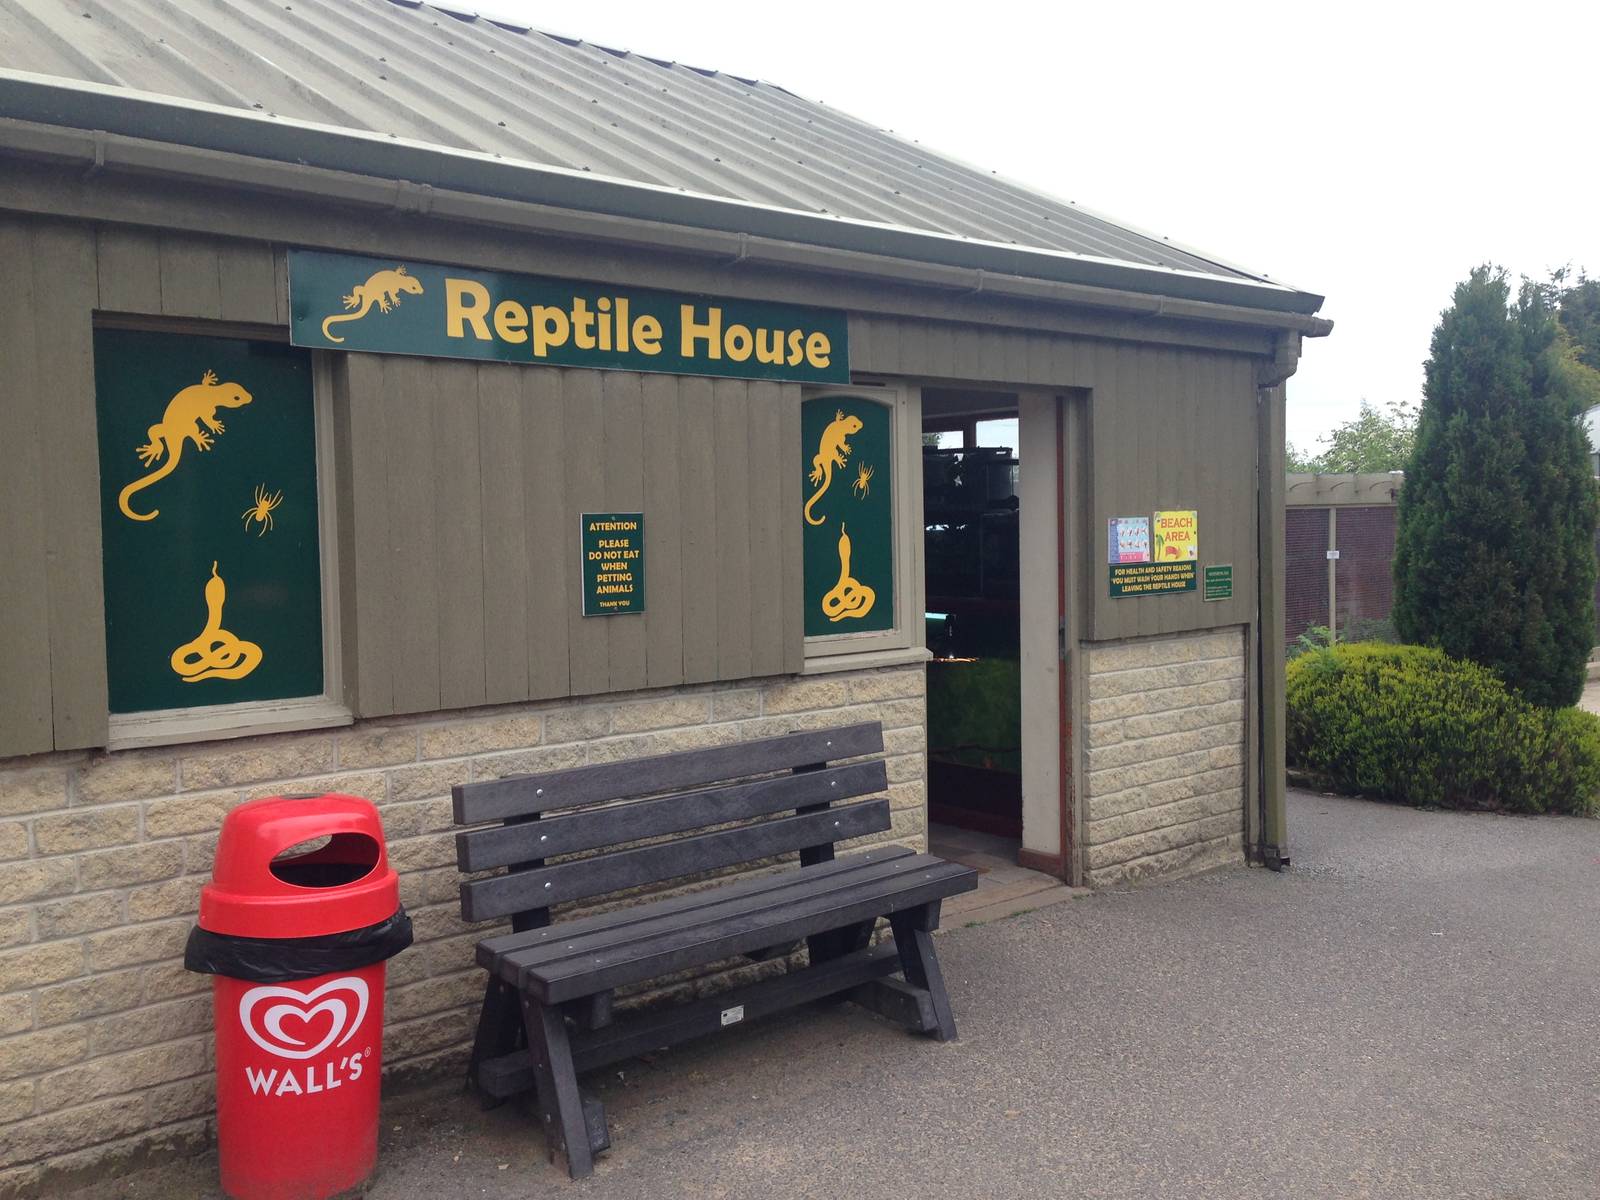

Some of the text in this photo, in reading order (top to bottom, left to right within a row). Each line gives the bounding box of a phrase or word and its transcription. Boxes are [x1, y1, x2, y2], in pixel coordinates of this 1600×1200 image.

[444, 277, 831, 369] Reptile House
[590, 522, 637, 531] ATTENTION
[1161, 517, 1192, 528] BEACH
[1165, 531, 1190, 542] AREA
[599, 539, 629, 548] PLEASE
[589, 550, 640, 560] DO NOT EAT
[601, 562, 628, 571] WHEN
[1156, 565, 1173, 573] SAFETY
[597, 573, 633, 582] PETTING
[1137, 575, 1150, 583] WASH
[596, 584, 633, 594] ANIMALS
[1152, 582, 1170, 590] REPTILE
[245, 1052, 363, 1097] WALL'S
